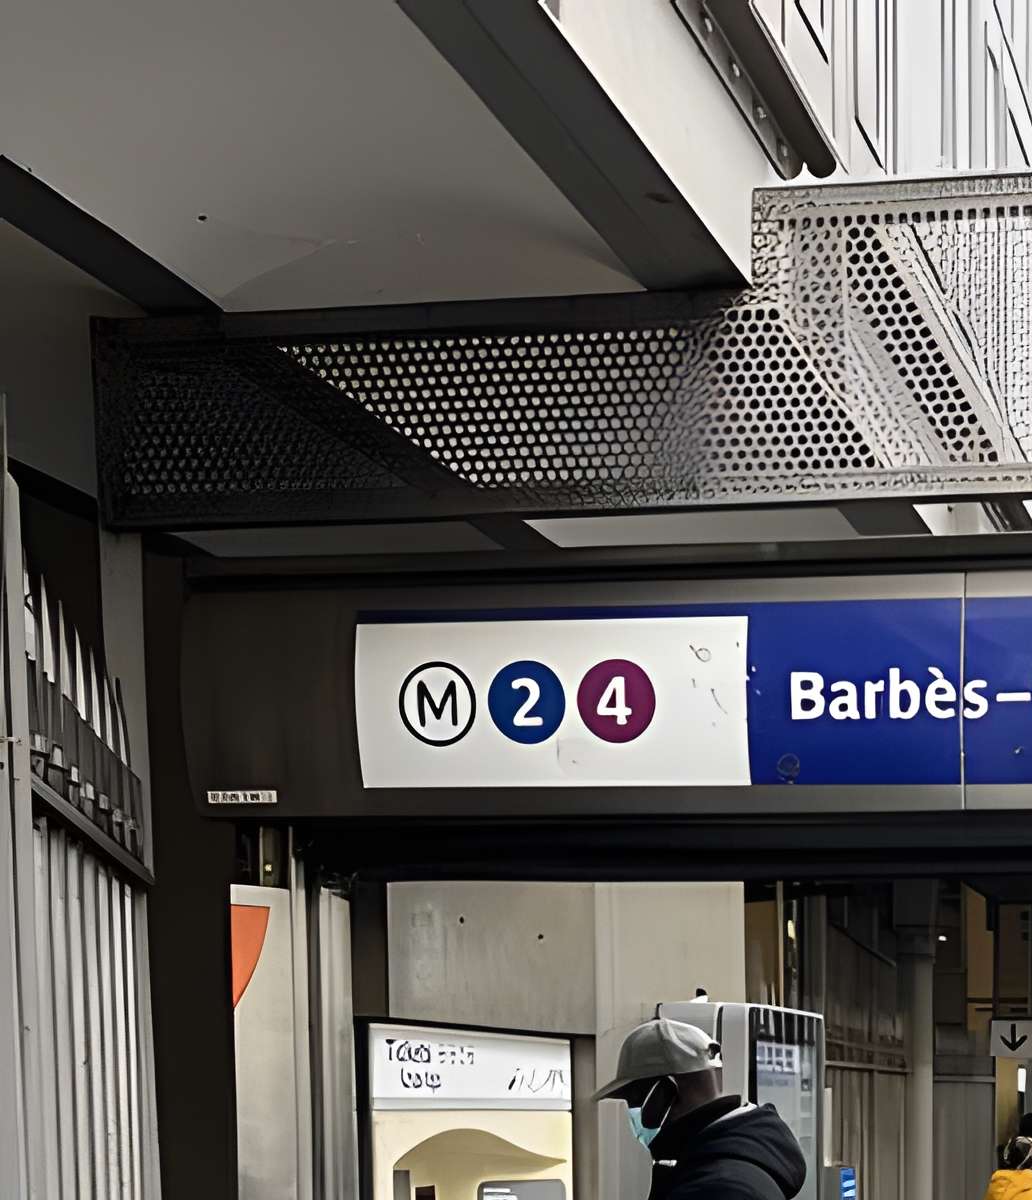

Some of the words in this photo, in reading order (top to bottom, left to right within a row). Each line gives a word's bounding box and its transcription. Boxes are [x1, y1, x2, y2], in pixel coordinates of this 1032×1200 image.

[415, 679, 459, 728] M
[511, 677, 543, 727] 2
[596, 675, 632, 726] 4
